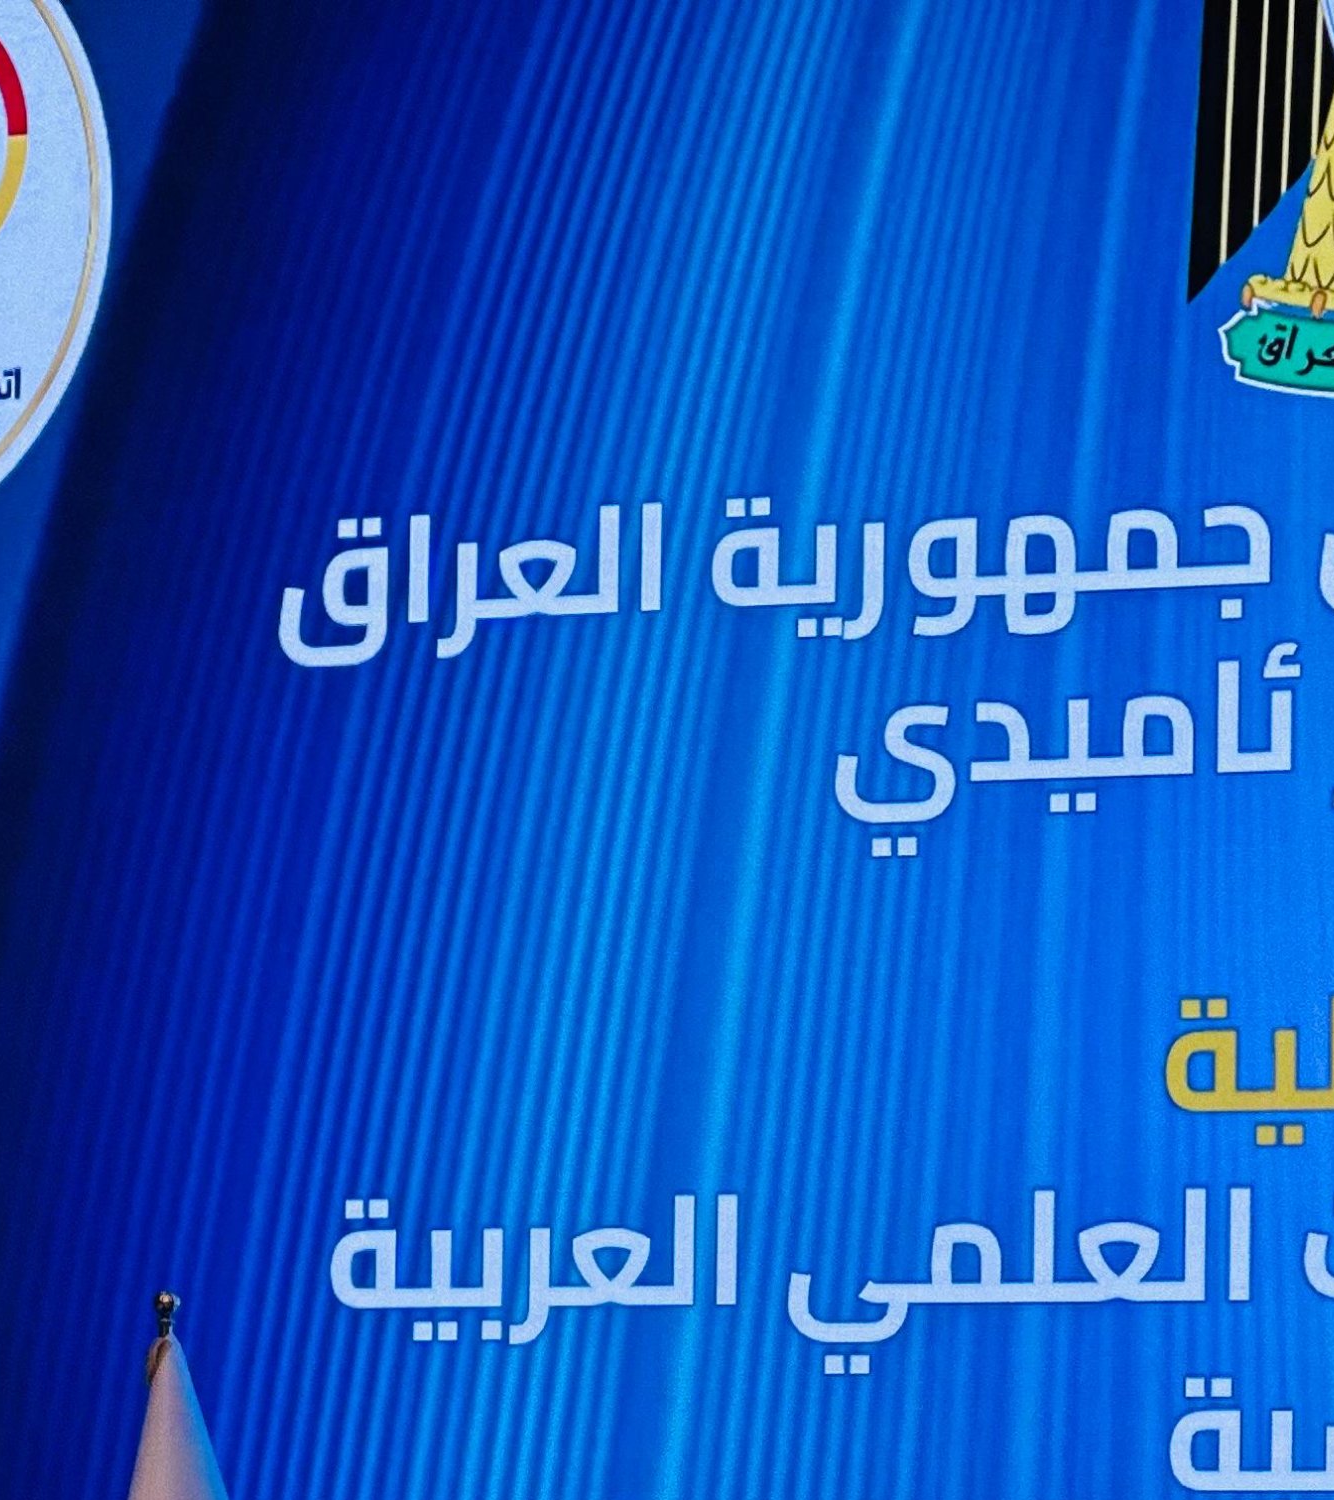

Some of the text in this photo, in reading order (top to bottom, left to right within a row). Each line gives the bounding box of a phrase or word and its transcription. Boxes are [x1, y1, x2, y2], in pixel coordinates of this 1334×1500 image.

[278, 502, 663, 667] العراق
[711, 497, 1271, 640] جمهورية
[834, 642, 1302, 857] ئاميدي
[330, 1194, 738, 1345] العربية
[787, 1188, 1251, 1375] العلمي
